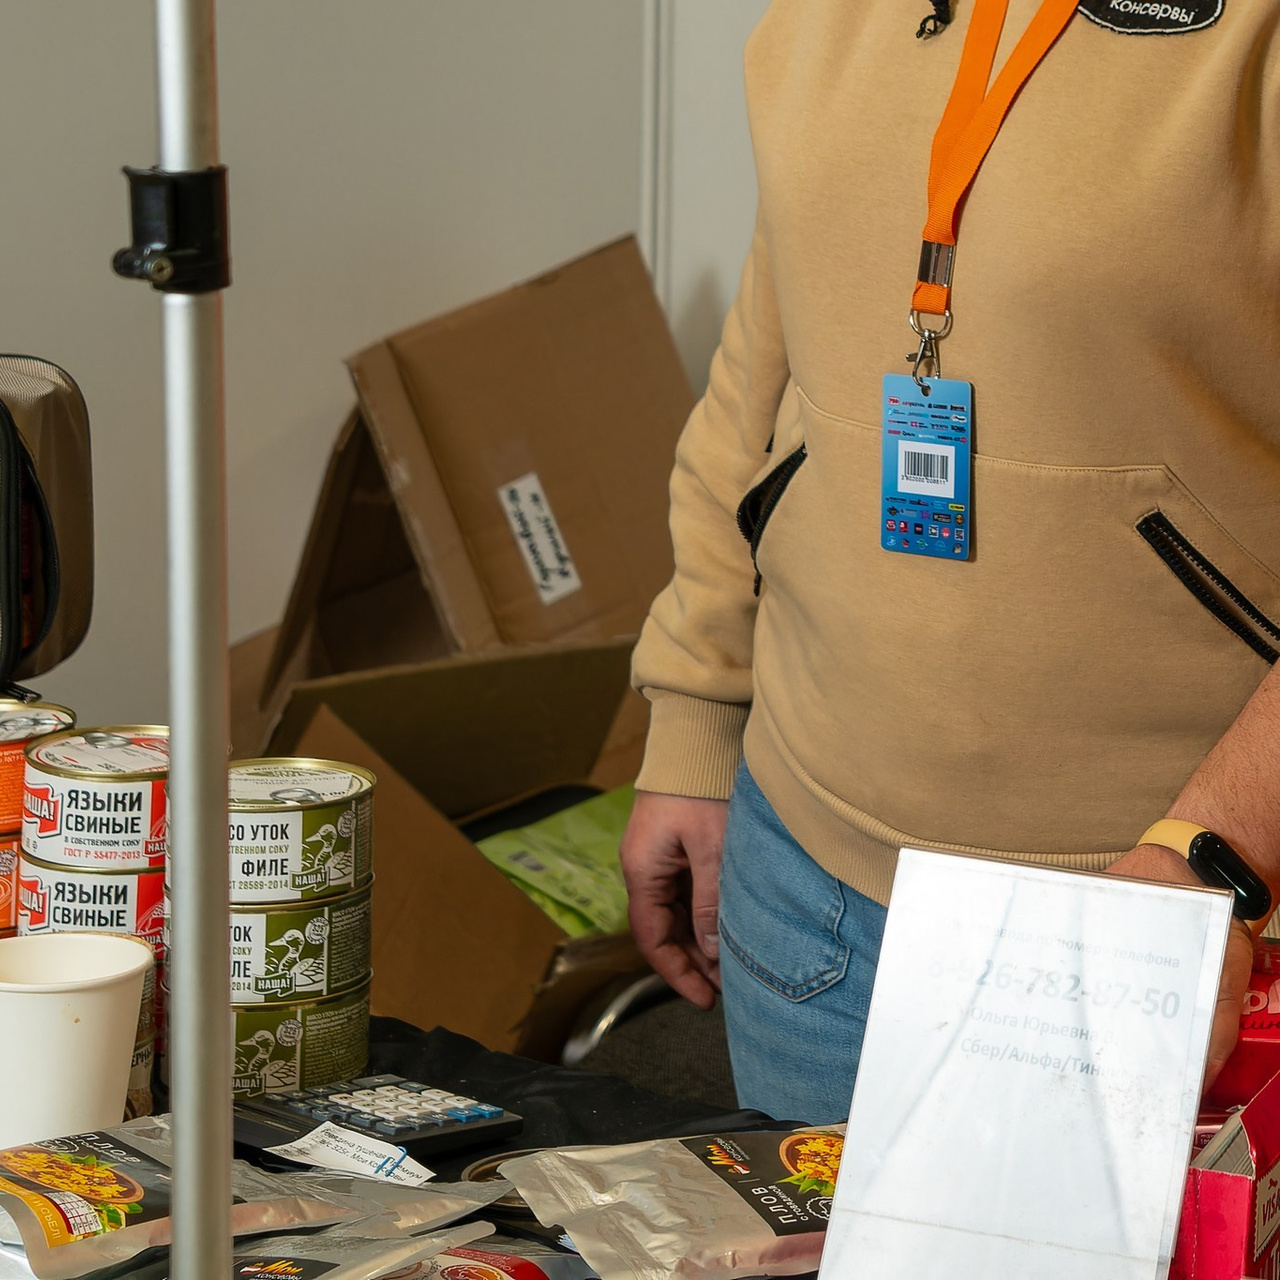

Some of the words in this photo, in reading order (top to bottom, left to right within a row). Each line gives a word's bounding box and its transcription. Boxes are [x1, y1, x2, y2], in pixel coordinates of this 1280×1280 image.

[67, 789, 143, 812] ЯЗЫКИ
[65, 813, 142, 834] СВИНЫЕ
[228, 824, 245, 841] СО
[251, 823, 290, 841] УТОК
[70, 836, 121, 847] СОБСТВЕННОМ
[268, 845, 289, 855] СОКУ
[241, 858, 289, 877] ФИЛЕ
[295, 873, 326, 886] НАША!
[54, 881, 128, 905] ЯЗЫКИ
[53, 906, 127, 927] СВИНЫЕ
[1113, 946, 1181, 969] телефона
[257, 978, 291, 990] НАША!
[970, 1006, 1019, 1028] Ольга
[81, 1133, 141, 1164] ПЛОВ
[751, 1186, 798, 1224] ПЛОВ
[1262, 1188, 1280, 1227] VISA
